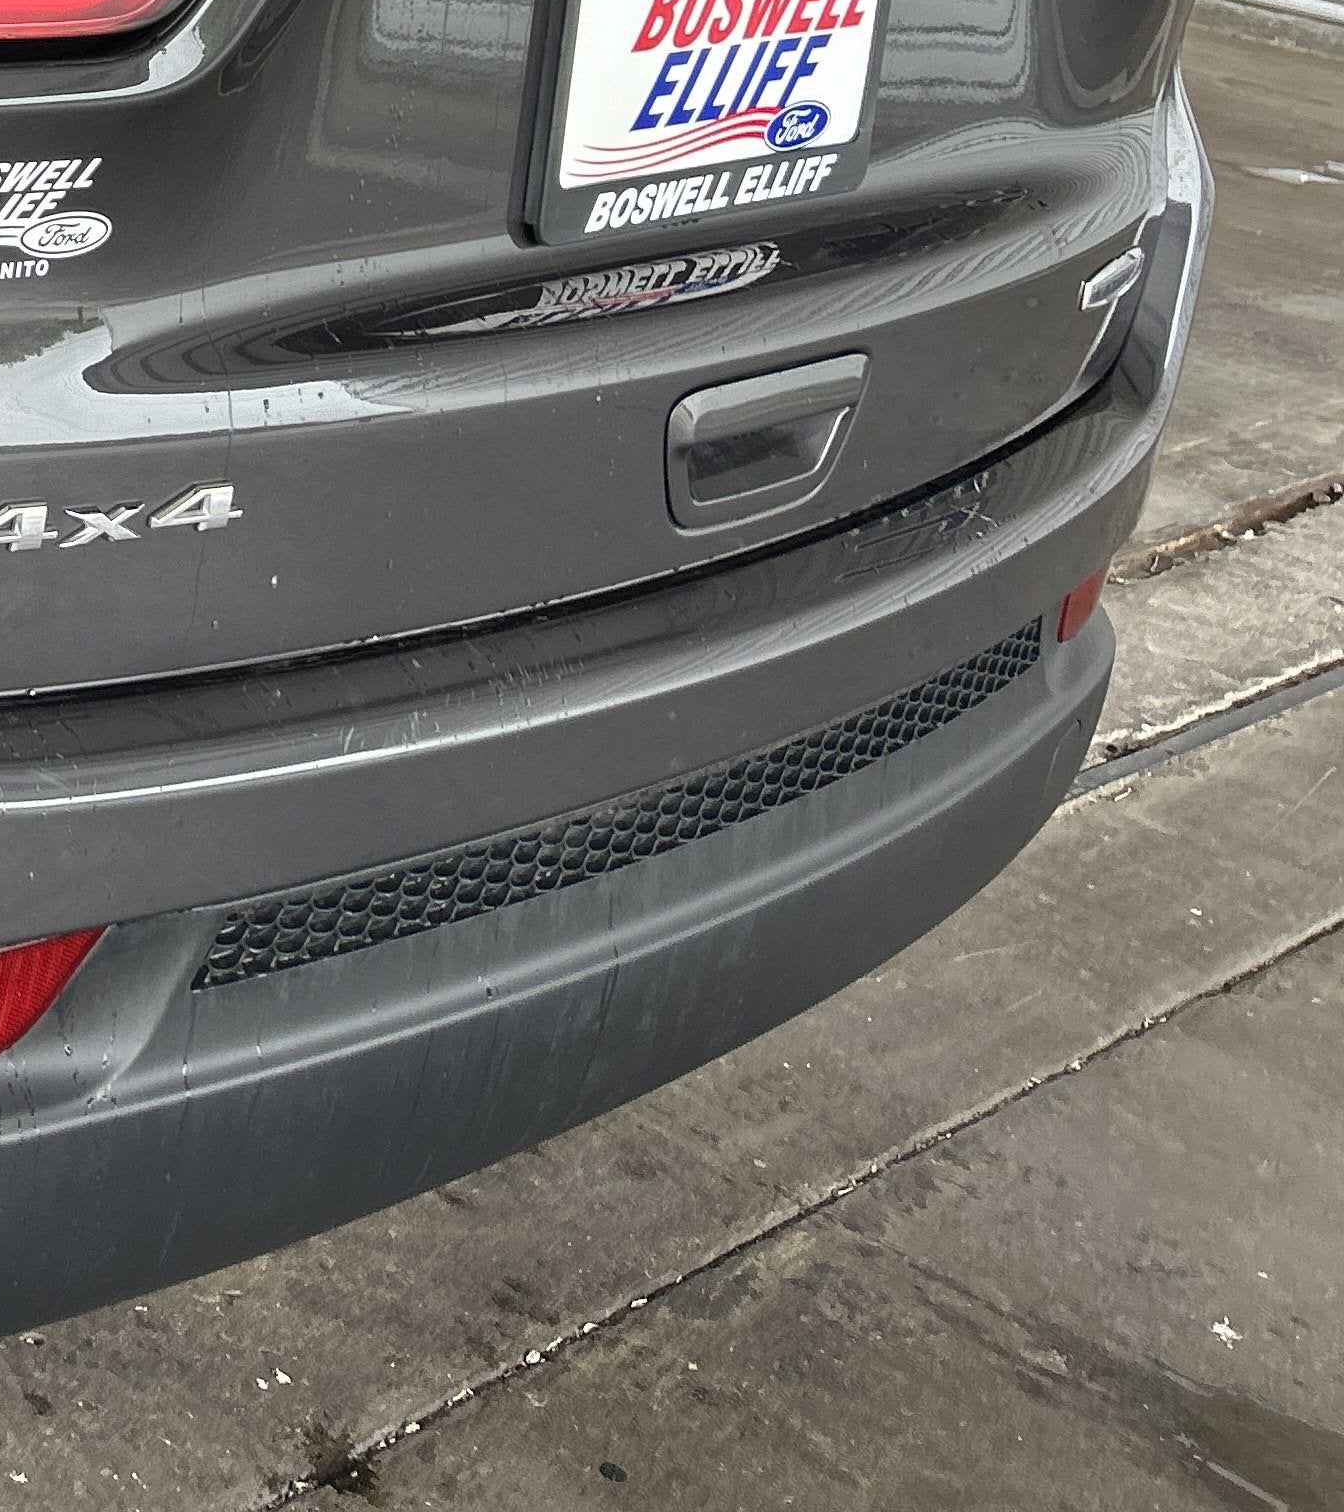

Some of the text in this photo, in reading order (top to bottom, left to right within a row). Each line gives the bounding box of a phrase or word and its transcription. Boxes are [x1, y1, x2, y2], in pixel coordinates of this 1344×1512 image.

[629, 34, 833, 132] ELLIFF
[774, 113, 820, 145] Ford
[583, 153, 839, 234] BOSWELL ELLIFF
[37, 223, 91, 248] Ford
